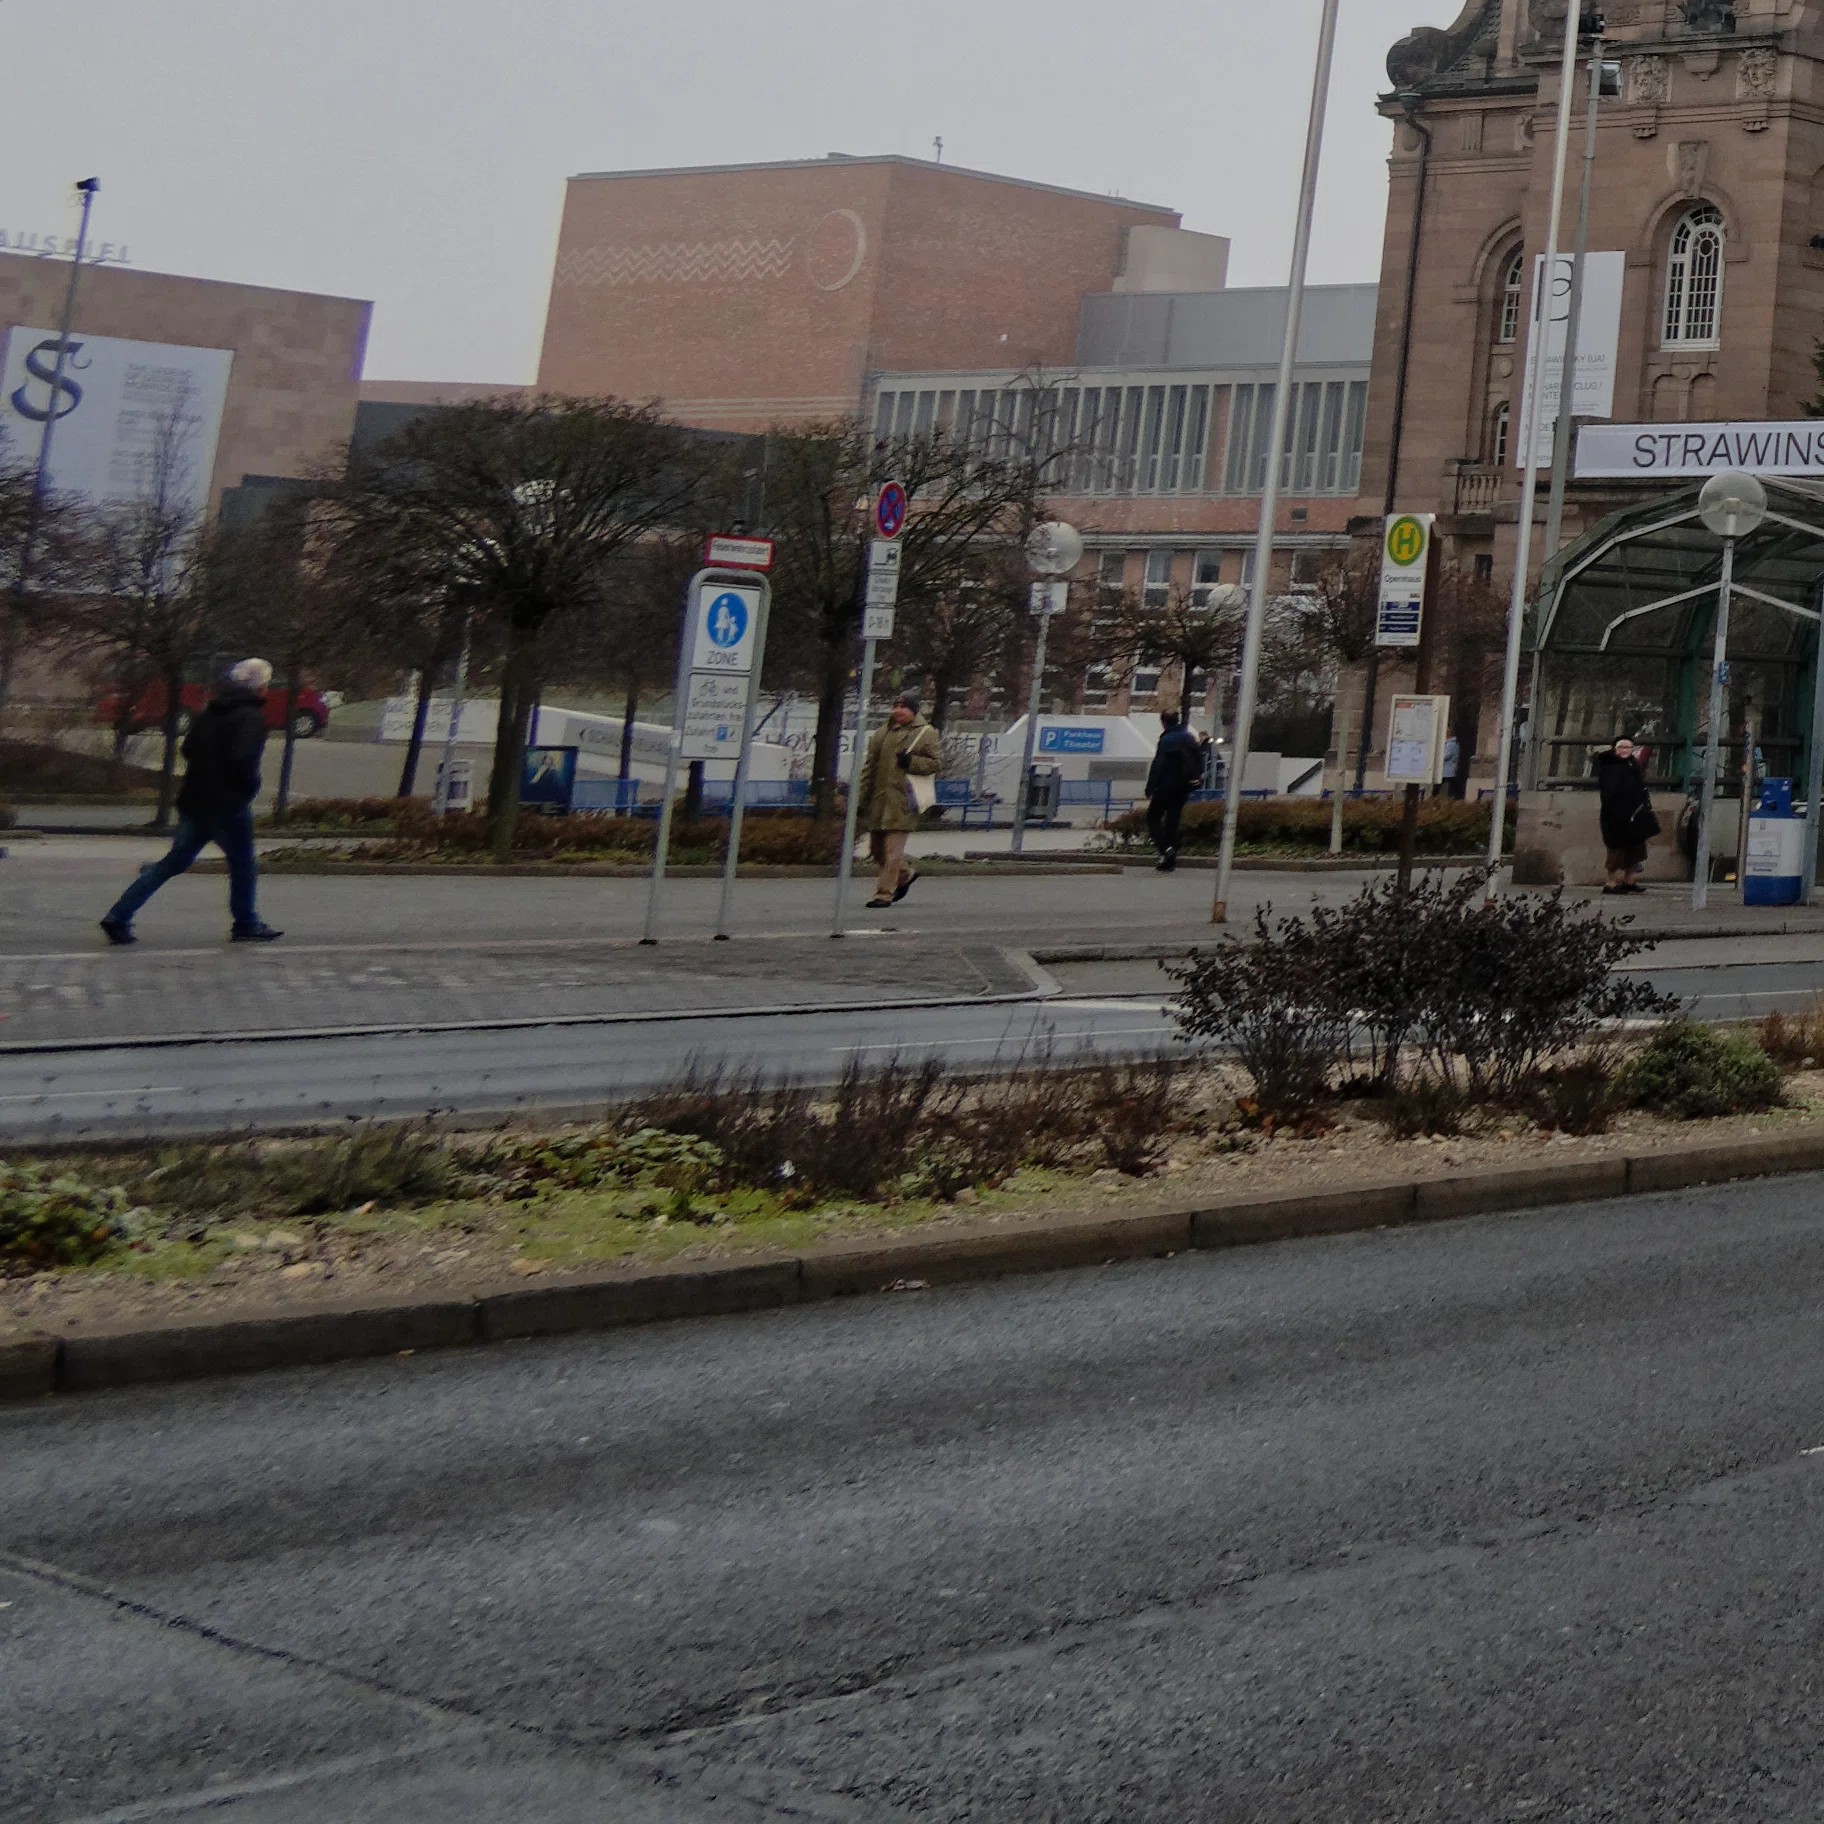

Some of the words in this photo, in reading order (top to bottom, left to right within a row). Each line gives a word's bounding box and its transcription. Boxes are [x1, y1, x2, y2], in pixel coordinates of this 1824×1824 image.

[1396, 527, 1416, 555] H
[707, 650, 739, 666] ZONE
[1045, 731, 1057, 746] P
